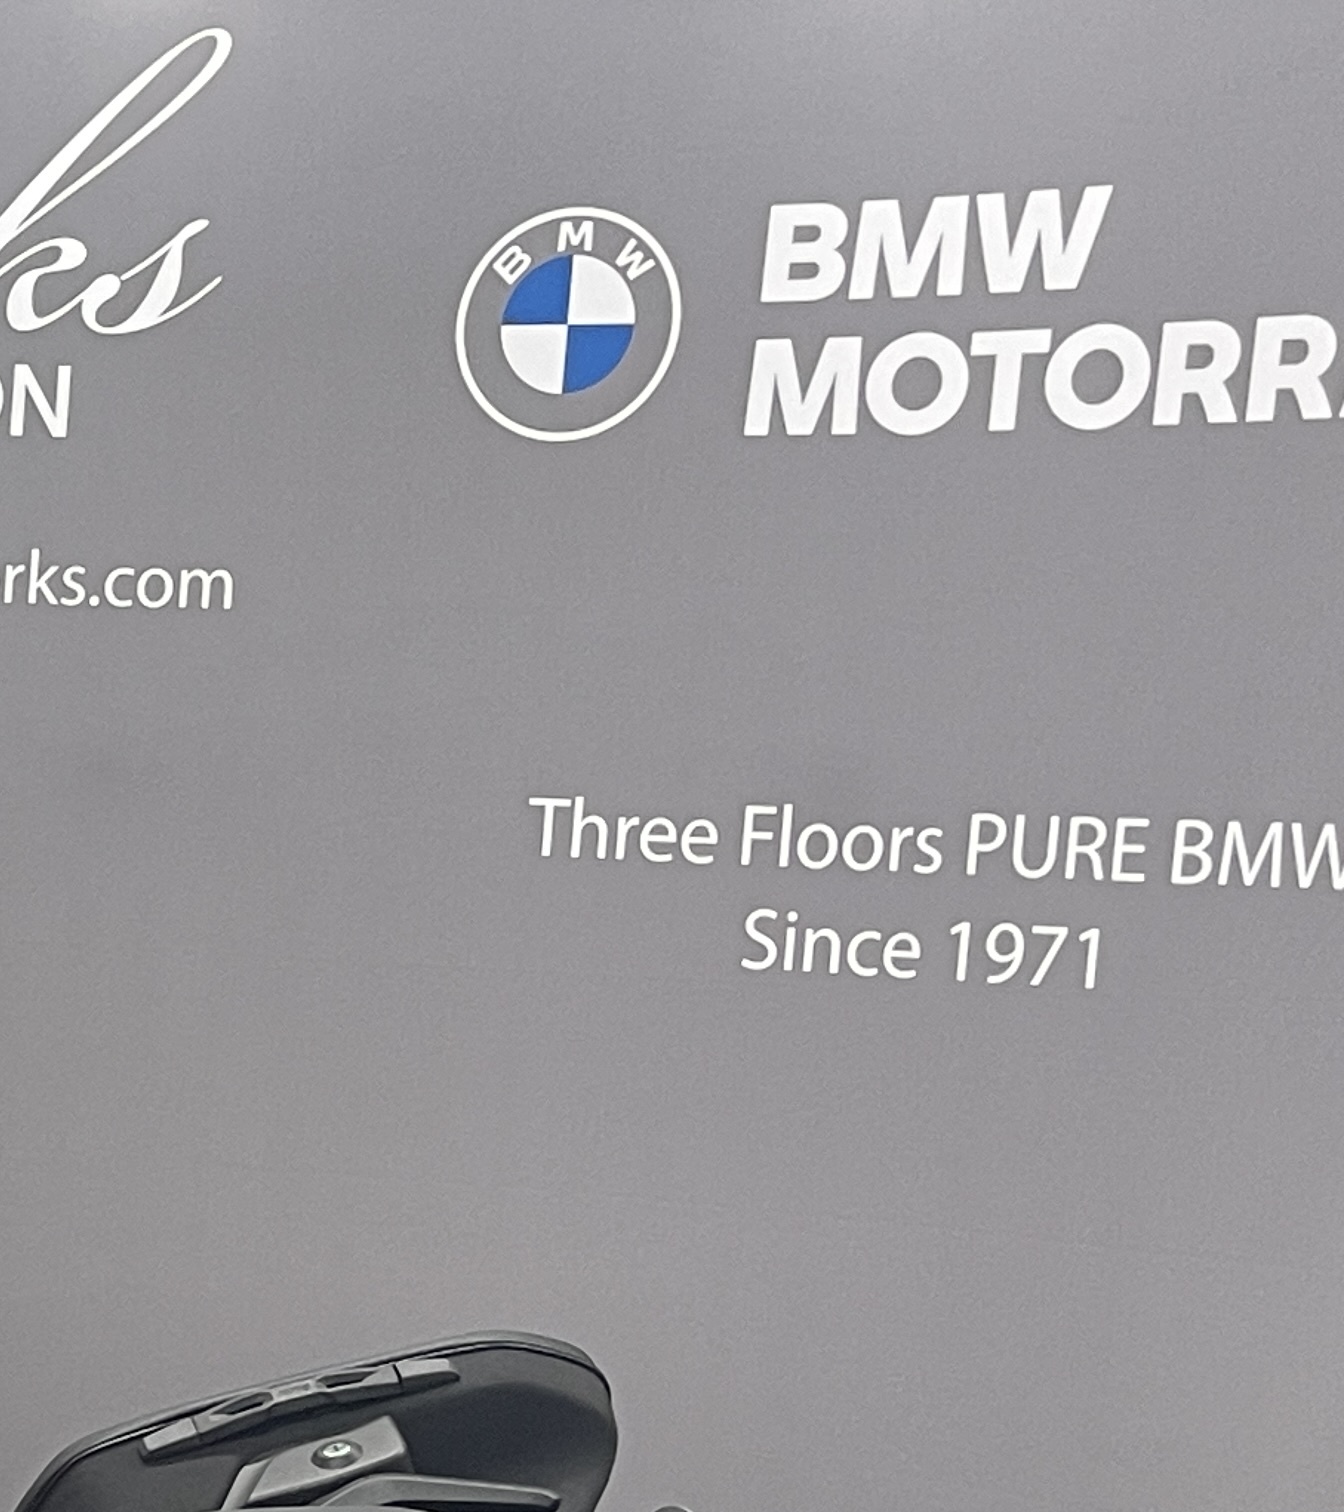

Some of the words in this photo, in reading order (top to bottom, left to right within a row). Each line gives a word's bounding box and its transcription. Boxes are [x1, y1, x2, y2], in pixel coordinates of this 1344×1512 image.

[491, 219, 657, 286] BMW
[759, 184, 1114, 303] BMW
[742, 313, 1344, 436] MOTORR
[527, 795, 720, 866] Three
[739, 803, 944, 876] Floors
[965, 811, 1151, 883] PURE
[1169, 818, 1344, 892] BMW
[739, 907, 922, 980] Since
[949, 920, 1101, 991] 1971
